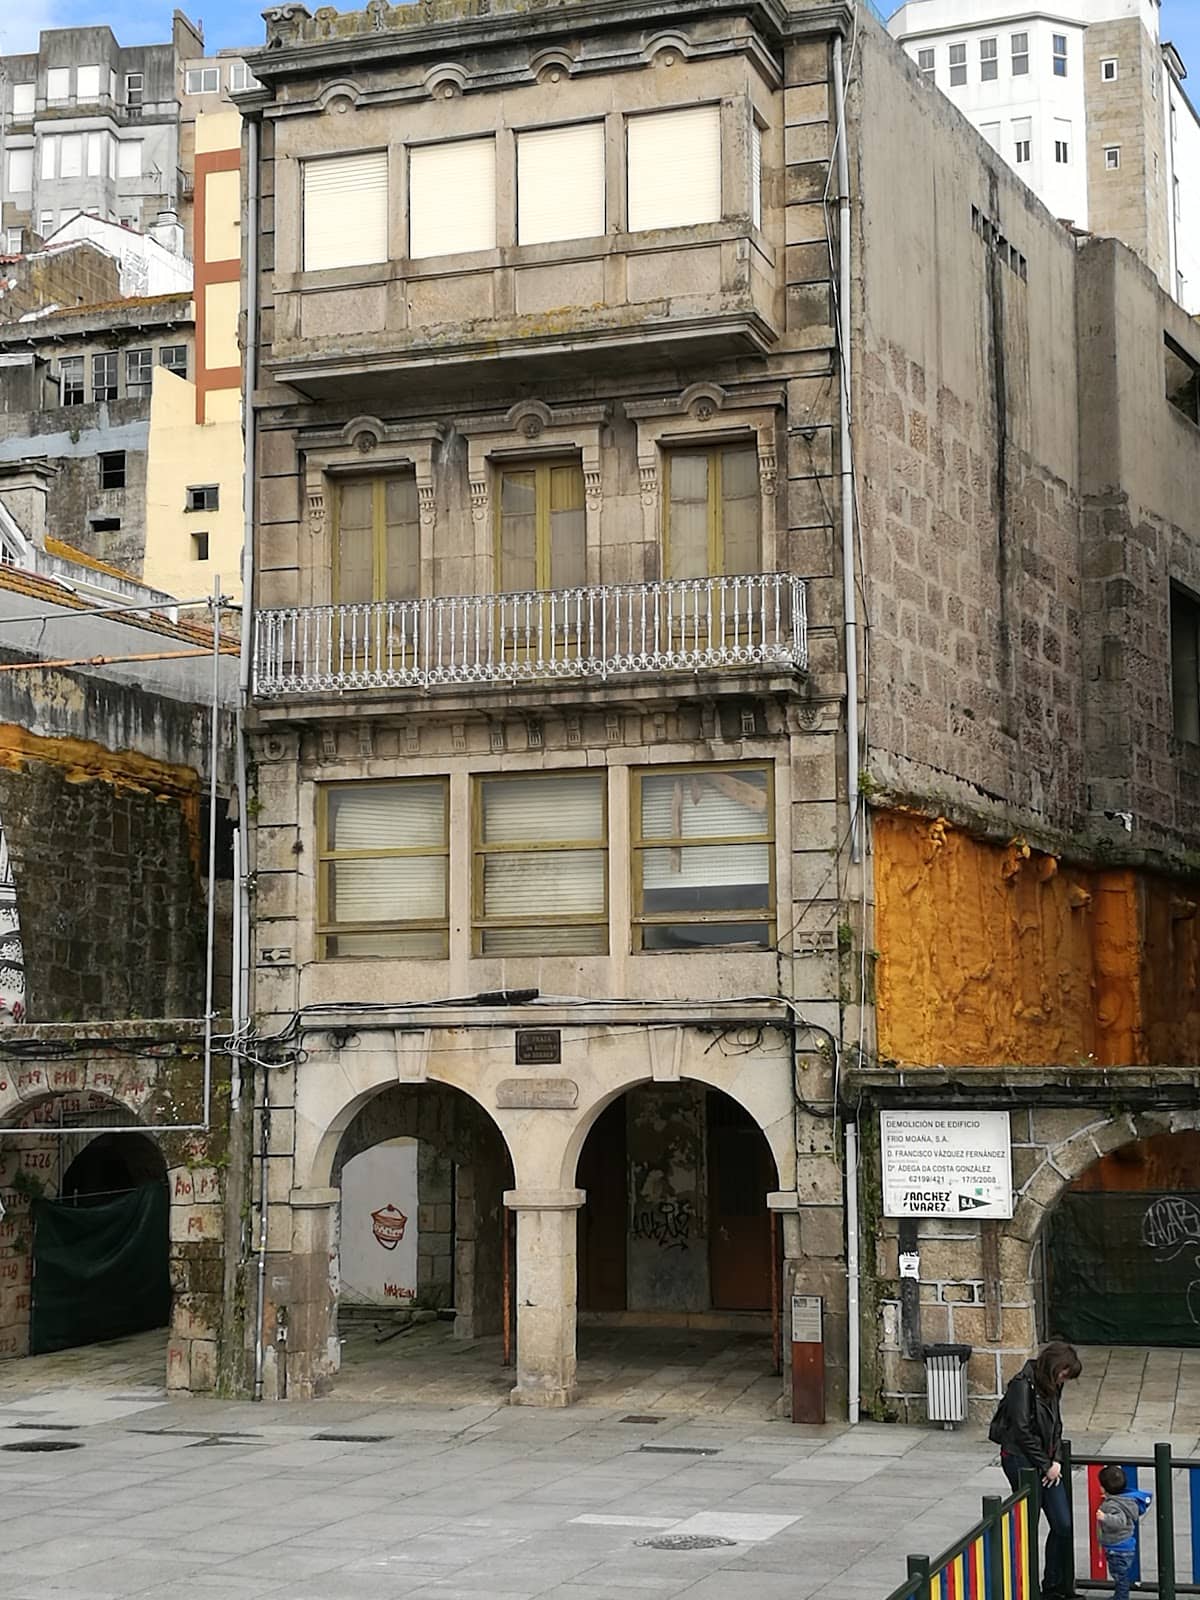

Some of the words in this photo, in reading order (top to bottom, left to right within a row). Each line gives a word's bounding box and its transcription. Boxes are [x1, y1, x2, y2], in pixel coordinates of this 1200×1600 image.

[886, 1119, 933, 1128] DEMOLICIÓN
[935, 1120, 946, 1128] DE
[947, 1120, 981, 1129] EDIFICIO
[887, 1135, 904, 1143] FRIO
[935, 1135, 949, 1143] S.A.
[895, 1149, 933, 1158] FRANCISCO
[934, 1148, 965, 1158] VÁZQUEZ
[965, 1148, 1006, 1159] FERNÁNDEZ
[921, 1164, 931, 1173] DA
[932, 1164, 954, 1173] COSTA
[955, 1163, 992, 1173] GONZÁLEZ
